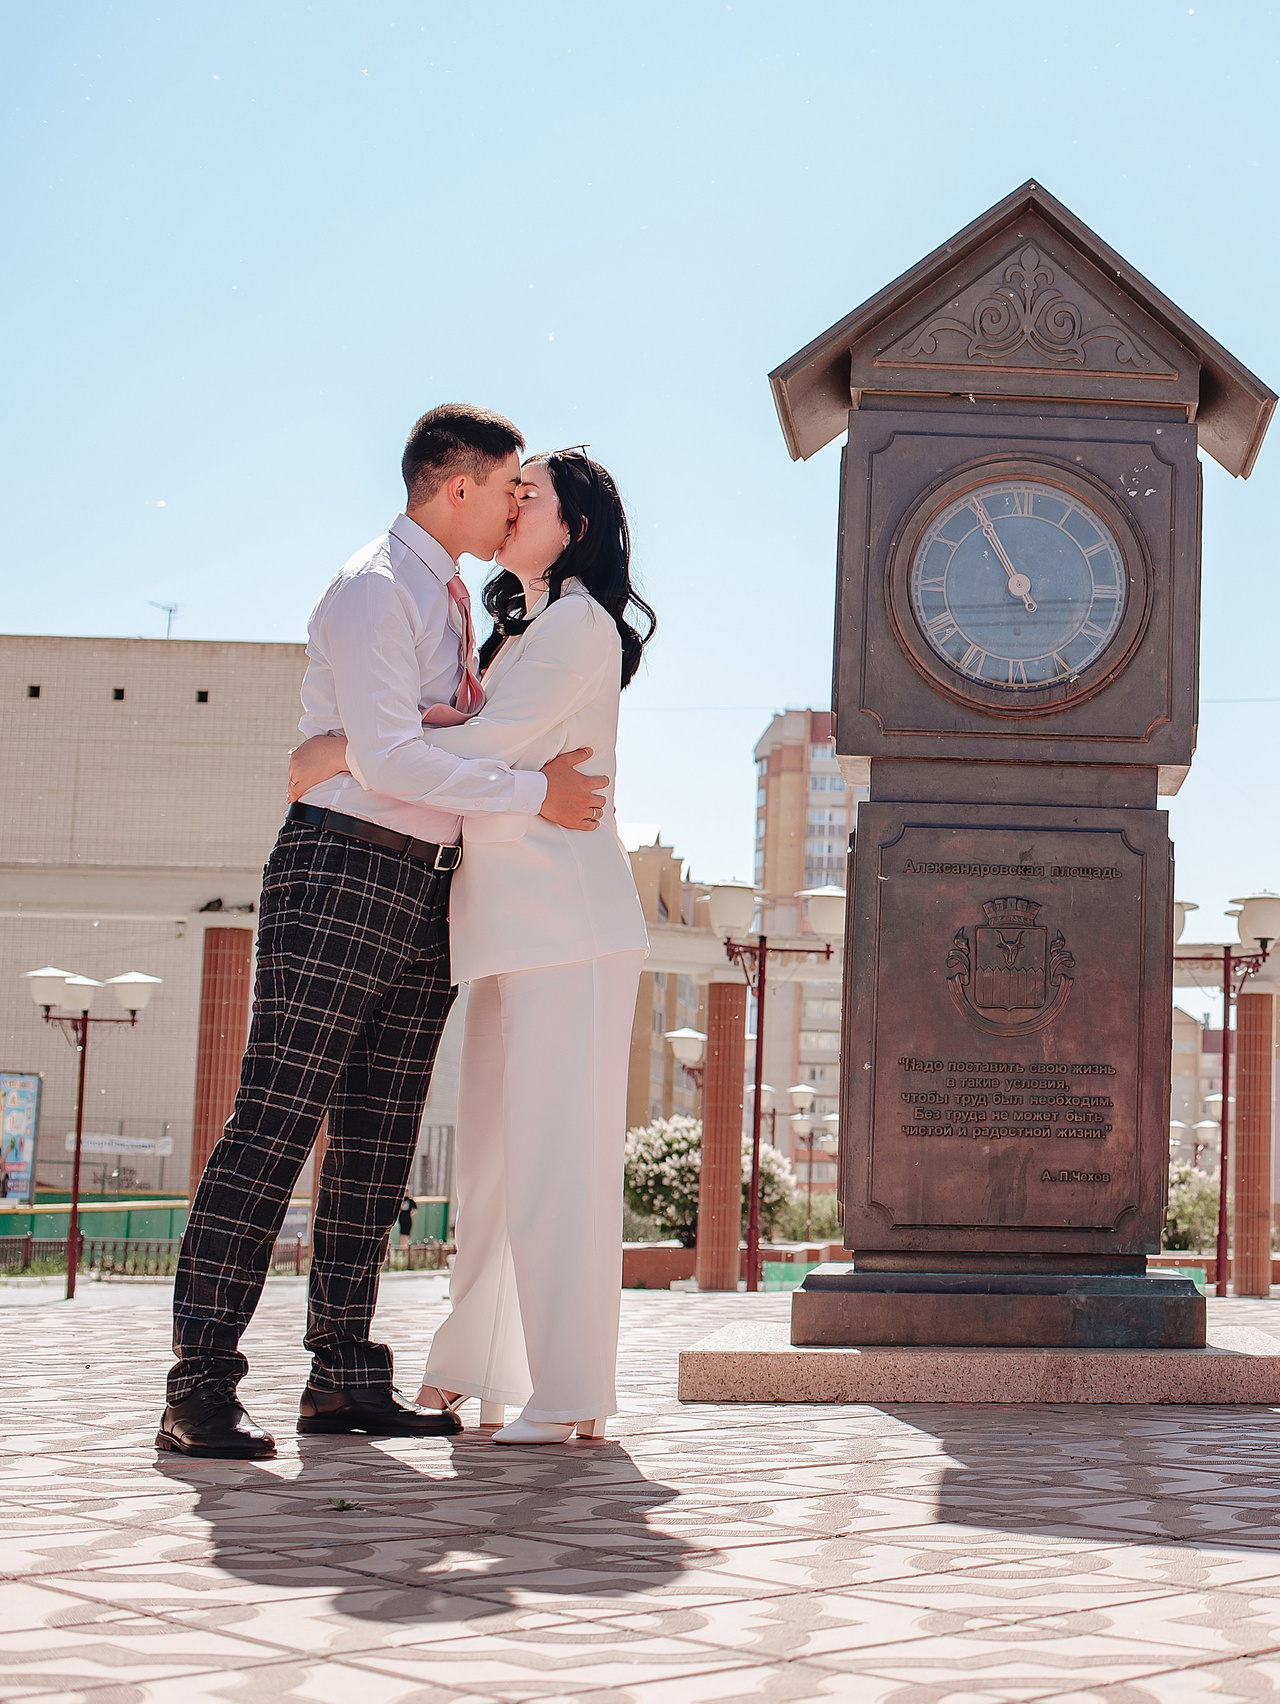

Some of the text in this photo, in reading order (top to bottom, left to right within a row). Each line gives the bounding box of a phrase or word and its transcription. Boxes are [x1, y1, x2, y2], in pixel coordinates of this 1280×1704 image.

[1011, 492, 1033, 515] XII
[1083, 541, 1109, 558] II
[1093, 584, 1119, 599] III
[1008, 660, 1028, 685] VI
[903, 859, 1122, 880] Александровская площадь
[948, 1060, 1025, 1074] поставить
[1029, 1062, 1068, 1075] свою
[1072, 1063, 1116, 1076] жизнь
[946, 1077, 1070, 1092] в такие условия,
[901, 1091, 1114, 1108] чтобы труд был необходим.
[914, 1107, 1104, 1123] Без труда не может быть
[901, 1124, 953, 1137] чистой
[958, 1125, 967, 1137] и
[972, 1125, 1051, 1139] радостной
